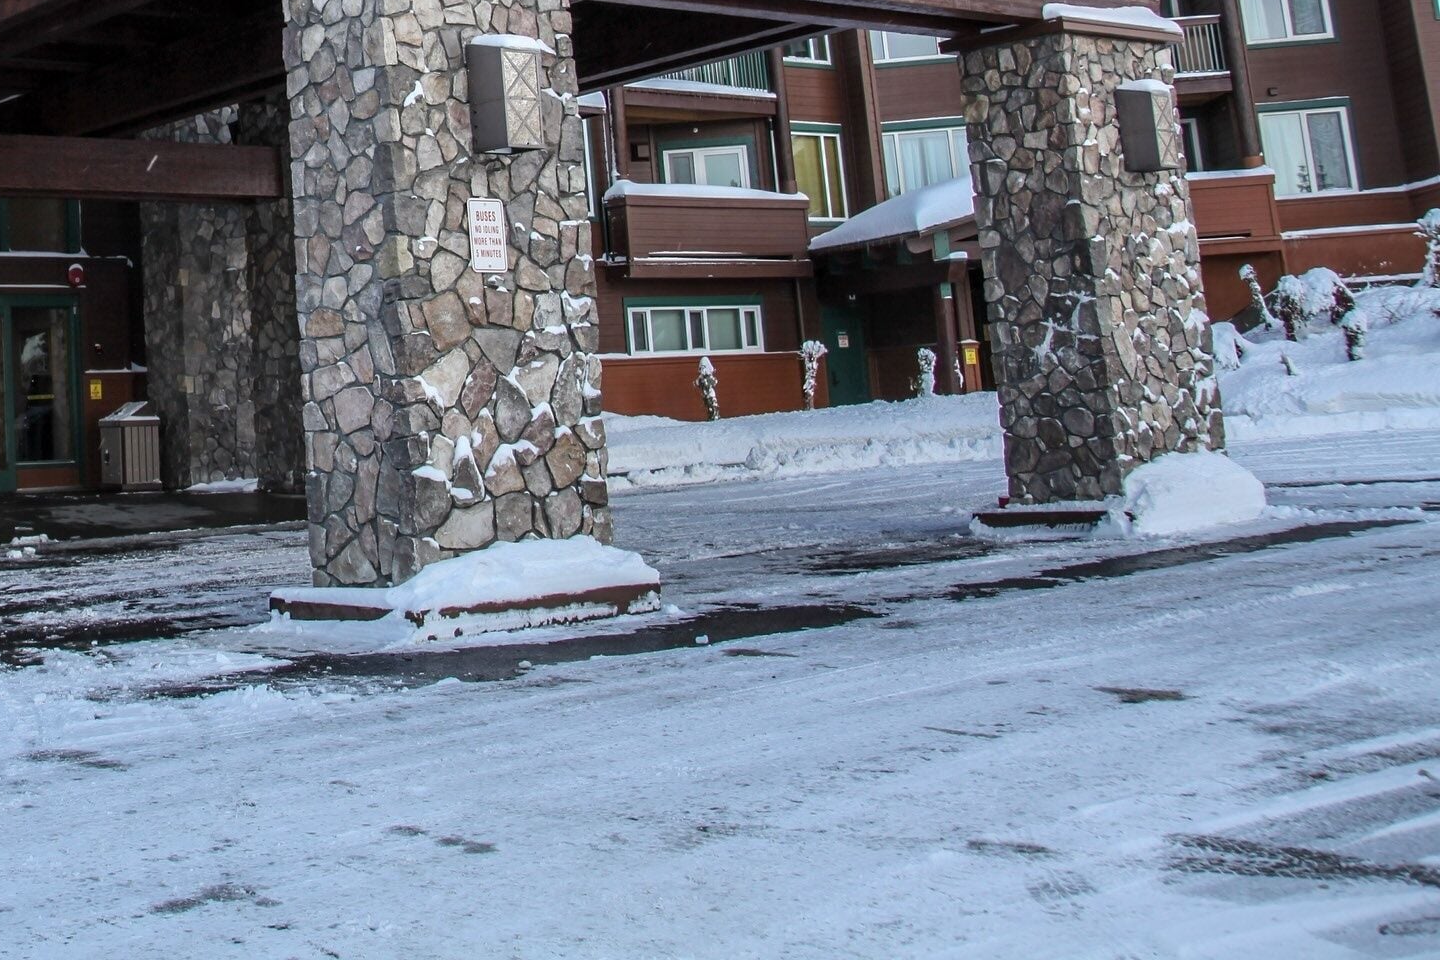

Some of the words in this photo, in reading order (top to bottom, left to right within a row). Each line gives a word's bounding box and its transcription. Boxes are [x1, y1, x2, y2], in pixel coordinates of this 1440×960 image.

[475, 210, 497, 222] BUSES
[474, 225, 482, 234] NO
[483, 225, 499, 234] IDLING
[474, 237, 488, 246] MORE
[489, 237, 502, 246] THAN
[476, 249, 480, 258] 5
[481, 249, 502, 258] MINUTES
